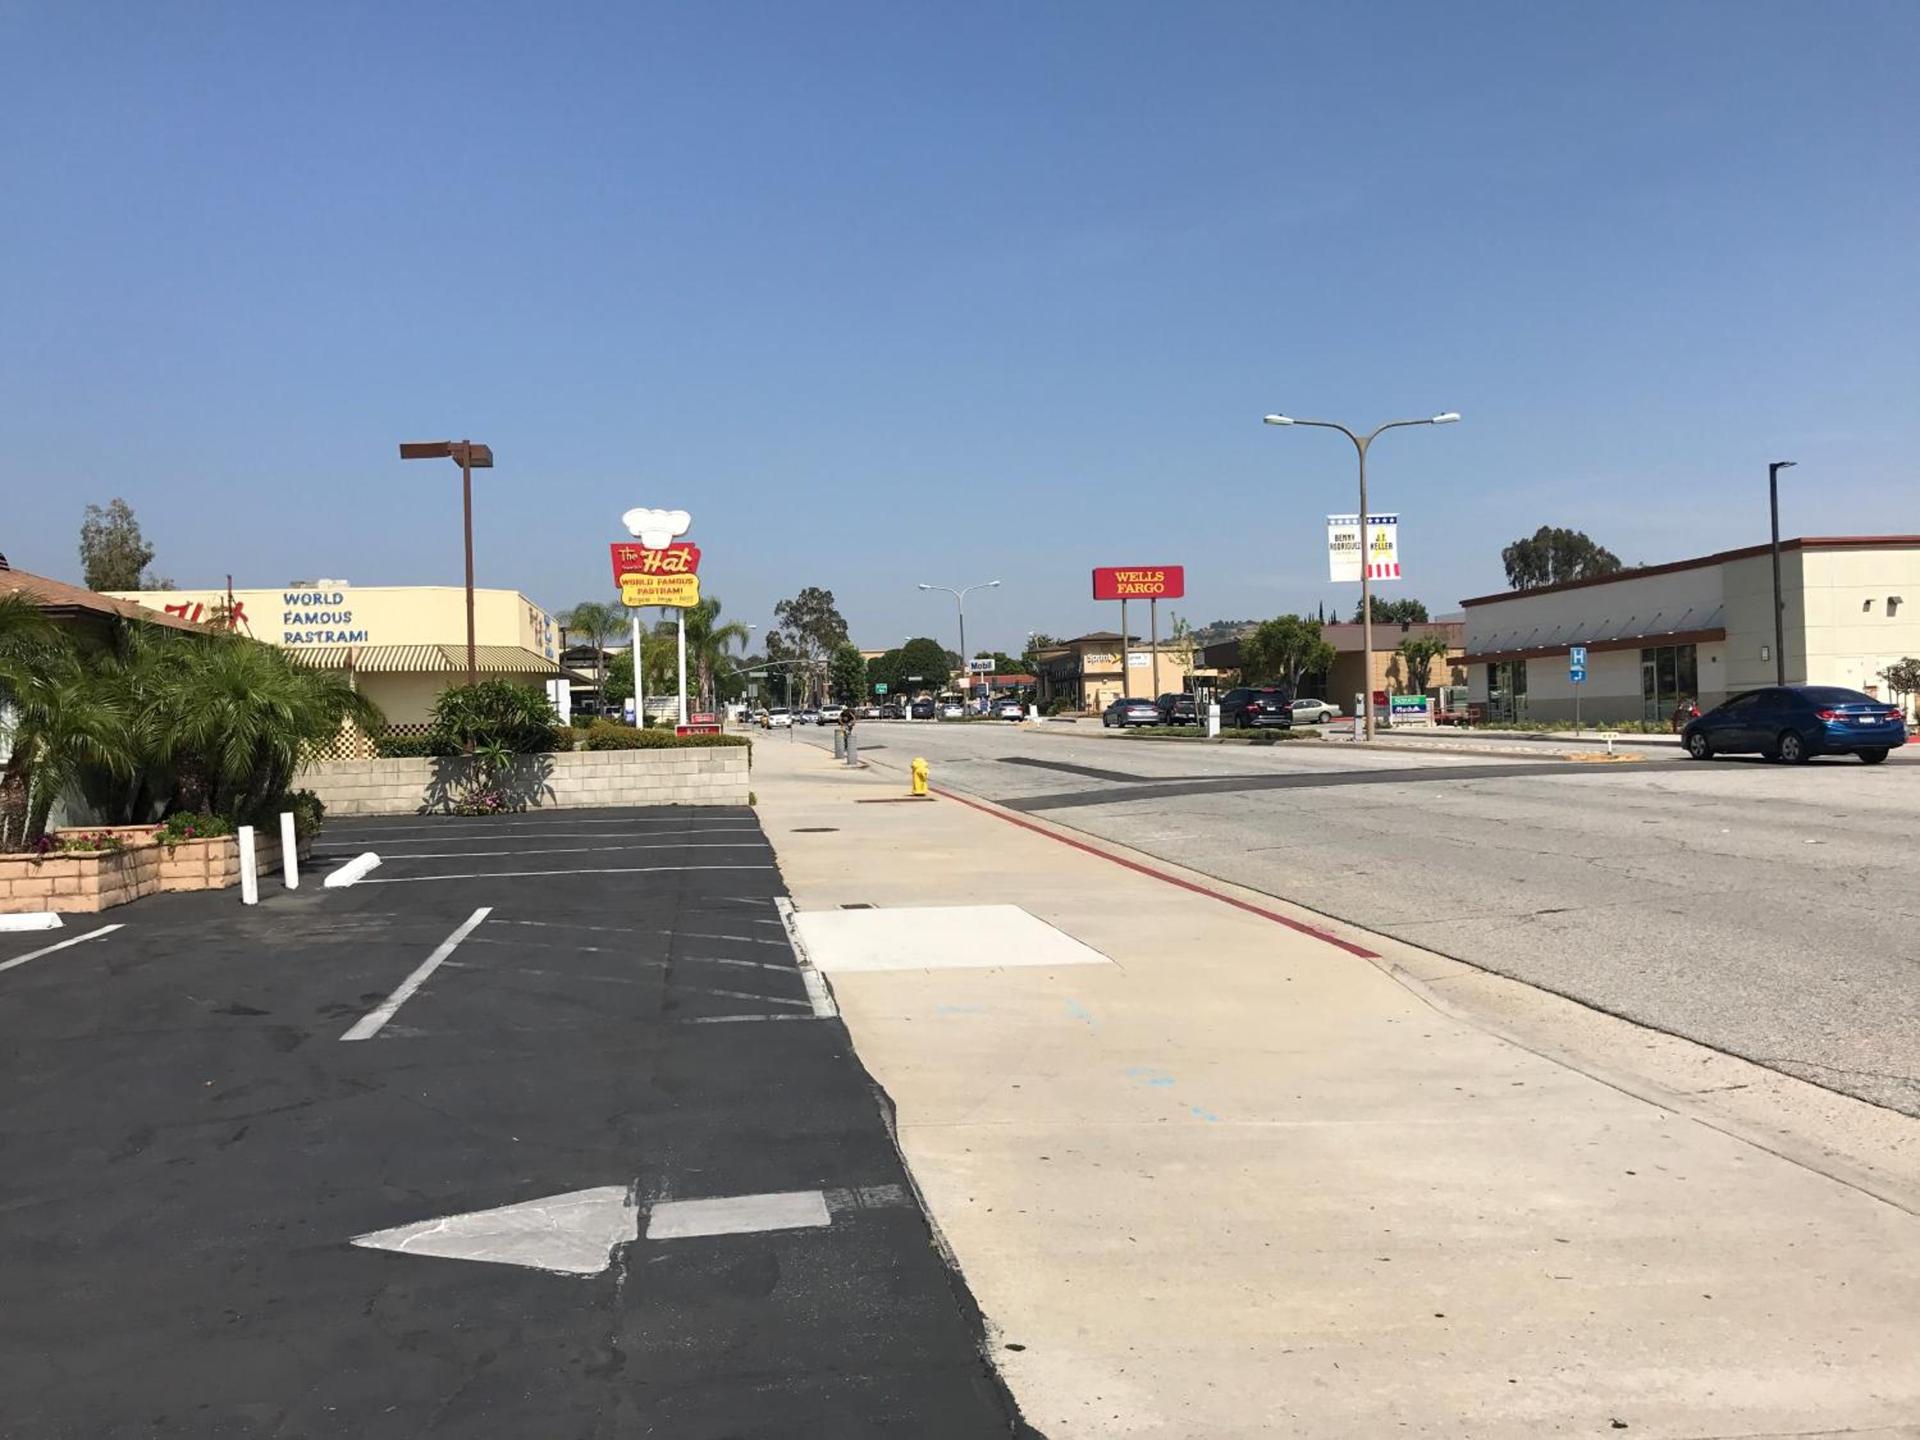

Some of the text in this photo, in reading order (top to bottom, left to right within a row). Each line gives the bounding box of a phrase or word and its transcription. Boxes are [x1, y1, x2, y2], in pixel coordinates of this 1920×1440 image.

[1329, 543, 1361, 551] RODRIGUEZ
[1370, 542, 1393, 551] KELLER
[618, 546, 692, 573] The Hat
[1114, 571, 1165, 582] WELLS
[622, 578, 694, 587] WORLD FAMOUS
[637, 587, 683, 596] PASTRAMI
[1117, 583, 1165, 594] FARGO
[283, 592, 344, 606] WORLD
[283, 610, 352, 625] FAMOUS
[284, 630, 368, 644] PASTRAMI
[1087, 652, 1112, 664] Sprint
[1573, 649, 1584, 664] H
[971, 661, 992, 670] Mobil
[686, 728, 710, 736] EXIT
